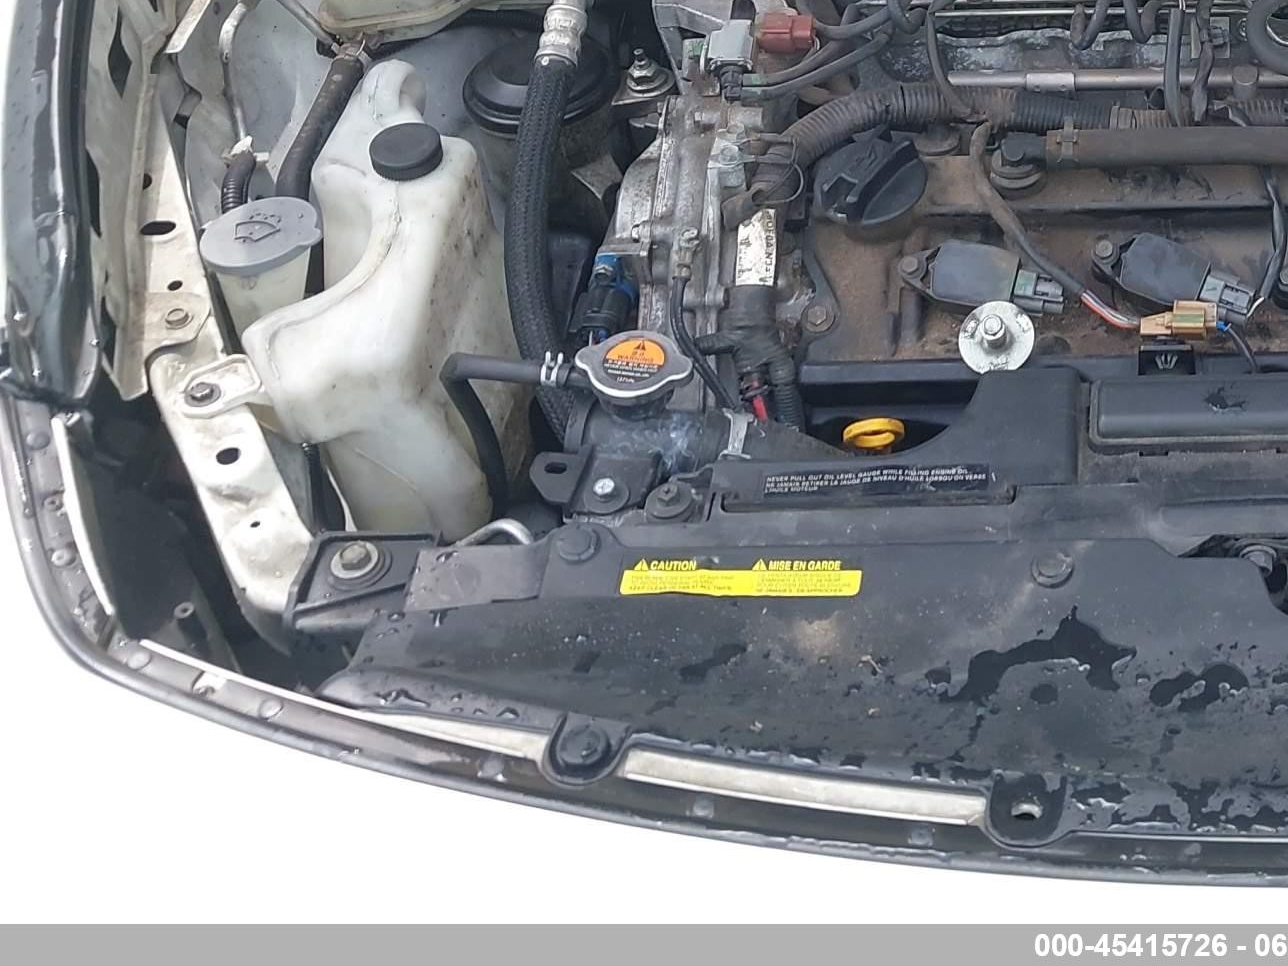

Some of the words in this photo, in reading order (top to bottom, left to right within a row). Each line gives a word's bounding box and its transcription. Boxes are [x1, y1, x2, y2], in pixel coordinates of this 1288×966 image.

[650, 560, 697, 571] CAUTION
[768, 560, 792, 571] MISE
[793, 560, 807, 571] EN
[807, 560, 842, 571] GARDE
